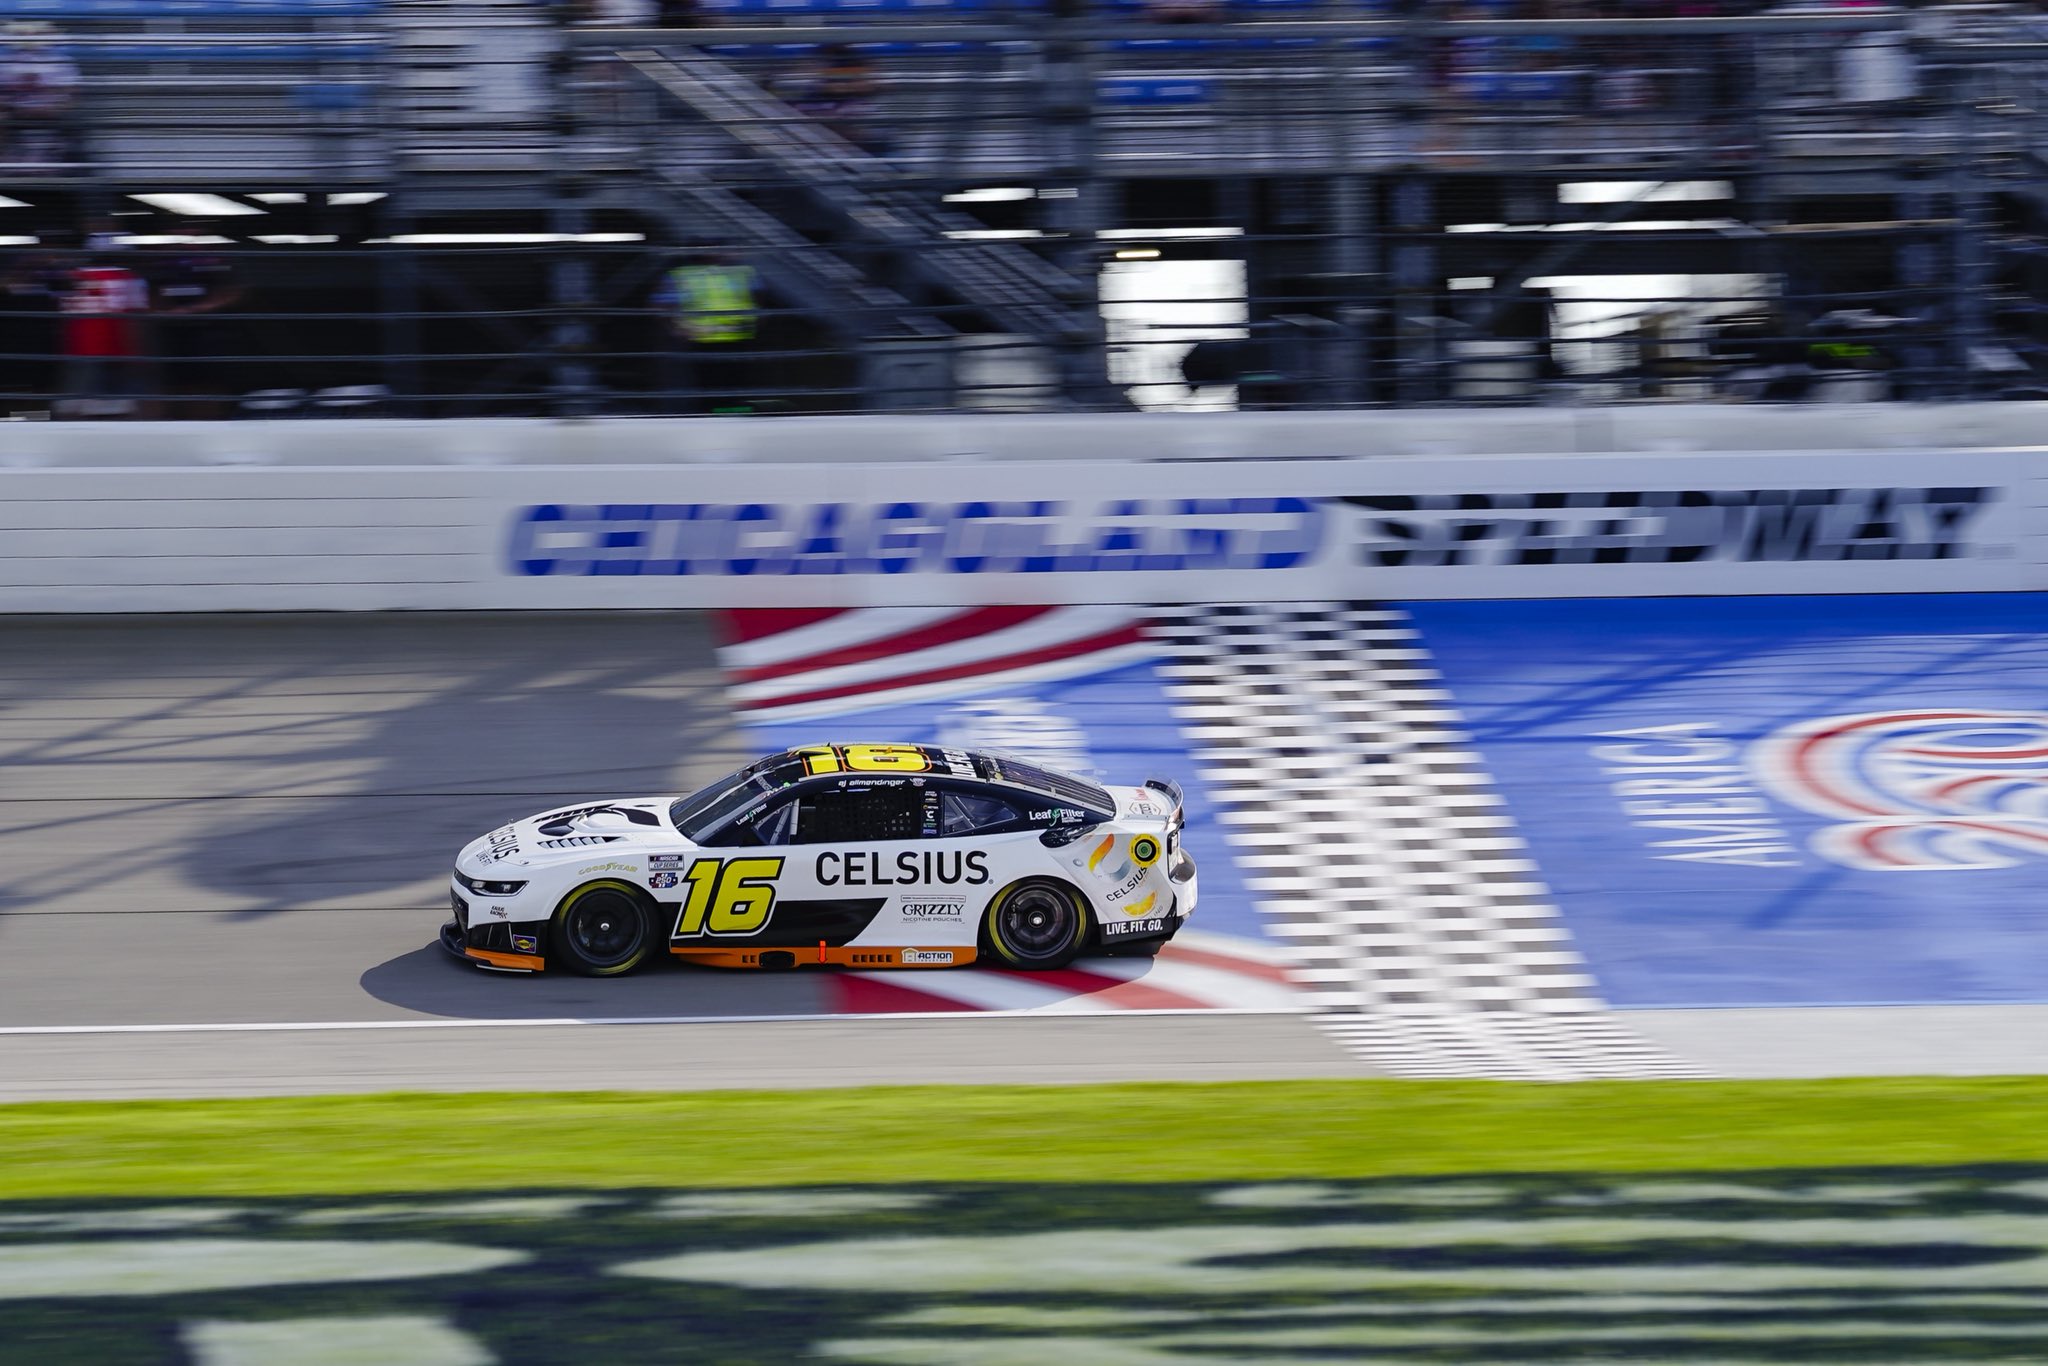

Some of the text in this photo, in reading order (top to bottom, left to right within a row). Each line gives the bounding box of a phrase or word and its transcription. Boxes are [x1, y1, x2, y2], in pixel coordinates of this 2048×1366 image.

[505, 486, 2005, 577] CHICAGOLAND SPEEDWAY
[849, 779, 905, 787] allmendinger
[1585, 722, 1803, 868] AMERICA
[1029, 809, 1052, 821] Leaf
[1060, 808, 1085, 818] Filter
[578, 862, 638, 876] GOODYEAR
[816, 850, 989, 886] CELSIUS
[672, 857, 785, 937] 16
[1106, 866, 1148, 902] CELSIUS
[902, 903, 964, 917] GRIZZLY
[1106, 919, 1163, 935] LIVE. FIT. GO.
